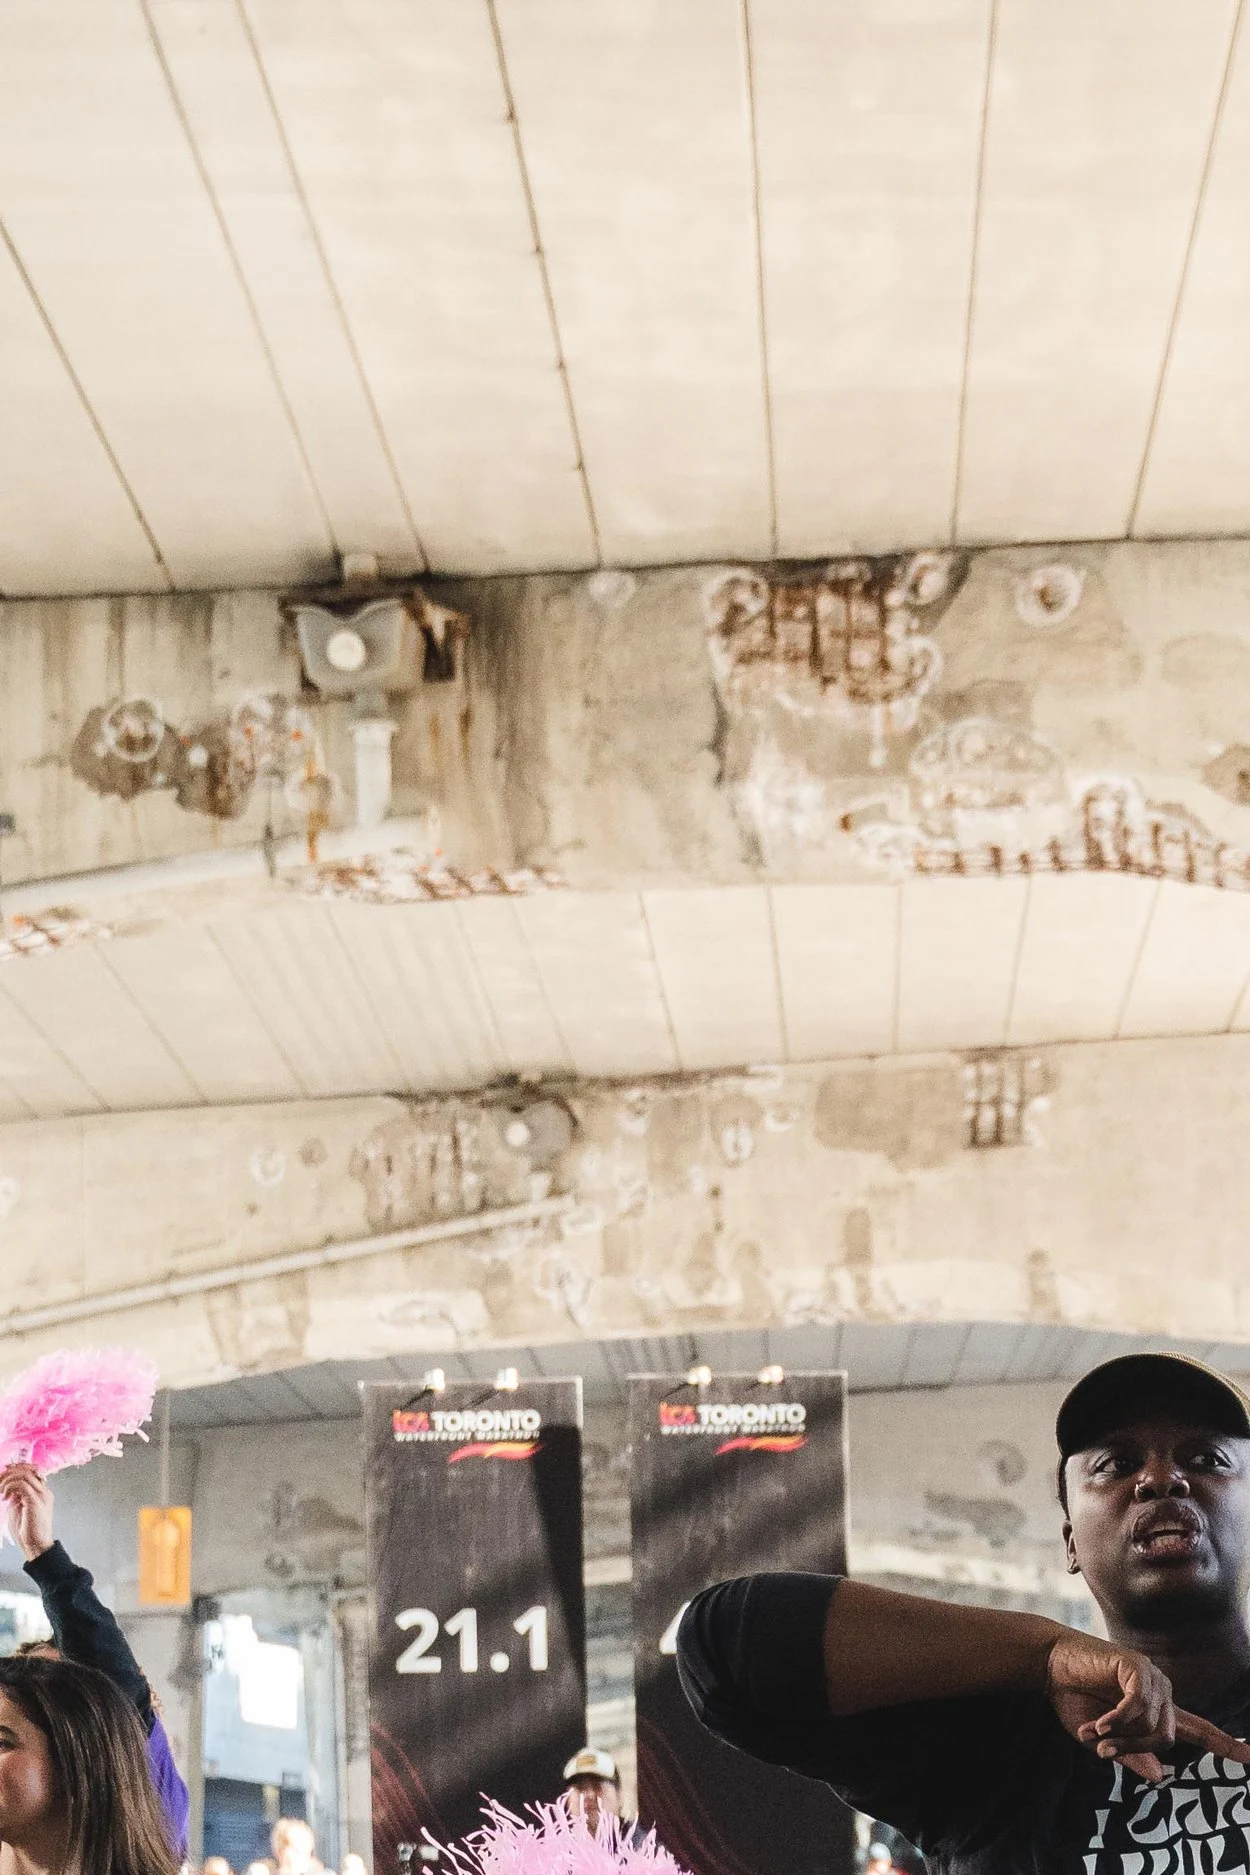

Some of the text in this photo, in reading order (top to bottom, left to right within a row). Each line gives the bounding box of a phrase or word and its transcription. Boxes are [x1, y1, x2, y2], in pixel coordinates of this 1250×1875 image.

[430, 1409, 541, 1431] TORONTO
[697, 1403, 807, 1424] TORONTO
[395, 1604, 549, 1674] 21.1
